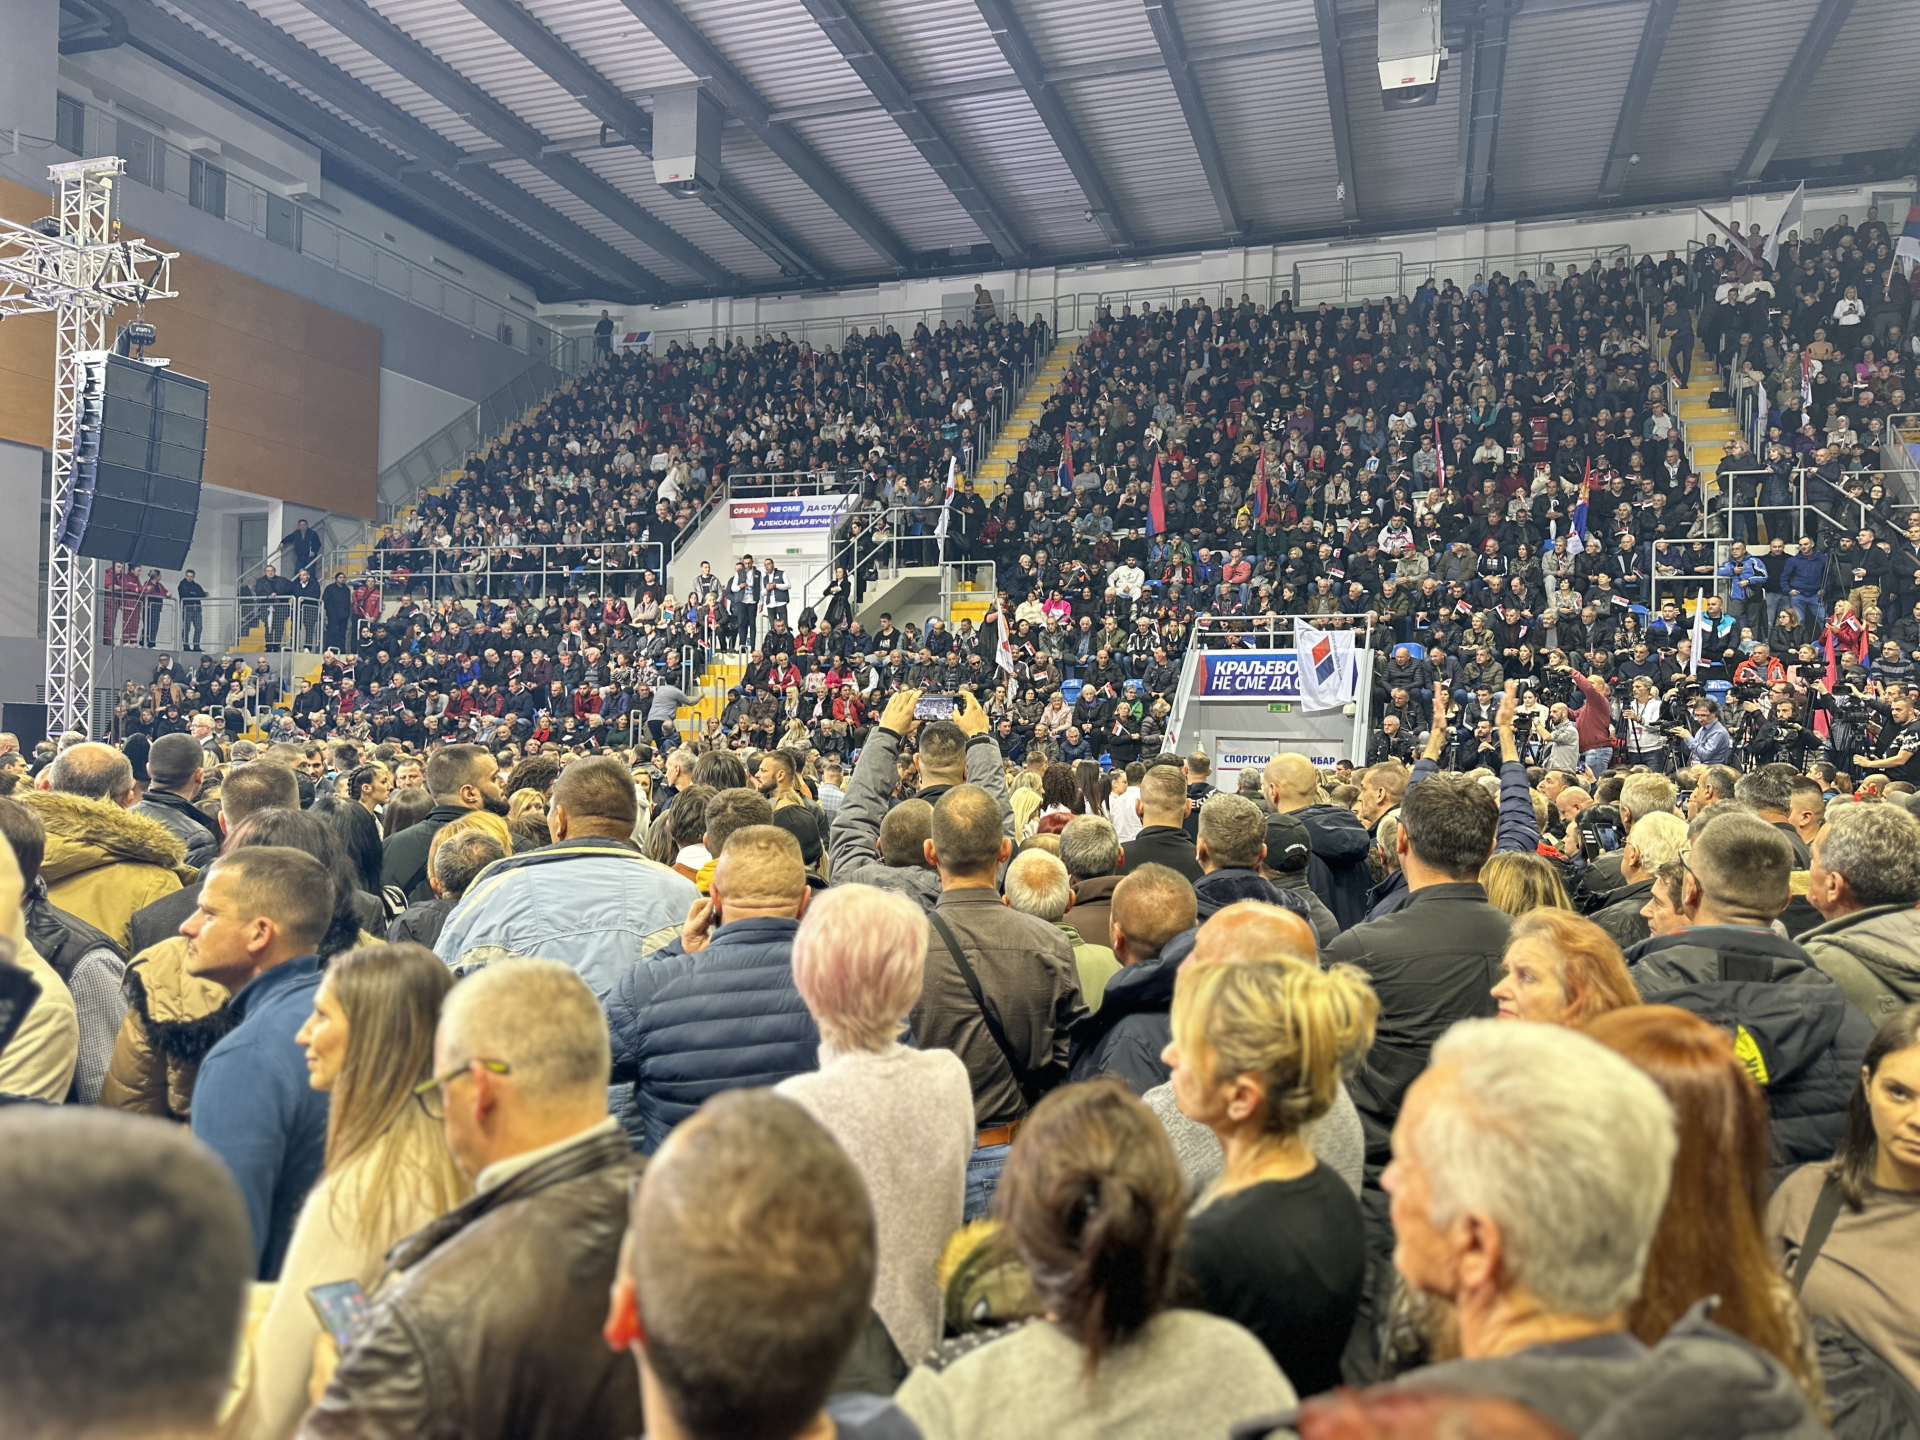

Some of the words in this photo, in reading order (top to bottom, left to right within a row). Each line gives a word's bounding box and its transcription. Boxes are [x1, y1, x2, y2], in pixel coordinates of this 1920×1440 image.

[733, 507, 765, 515] СРБИЈА
[782, 505, 801, 513] СМЕ
[757, 519, 809, 527] АЛЕКСАНДАР
[1214, 660, 1299, 675] КРАЉЕВО
[1211, 676, 1232, 690] НЕ
[1235, 675, 1267, 690] СМЕ
[1268, 675, 1292, 691] ДА
[1224, 755, 1271, 764] СПОРТСКИ
[1310, 756, 1336, 765] ИБАР
